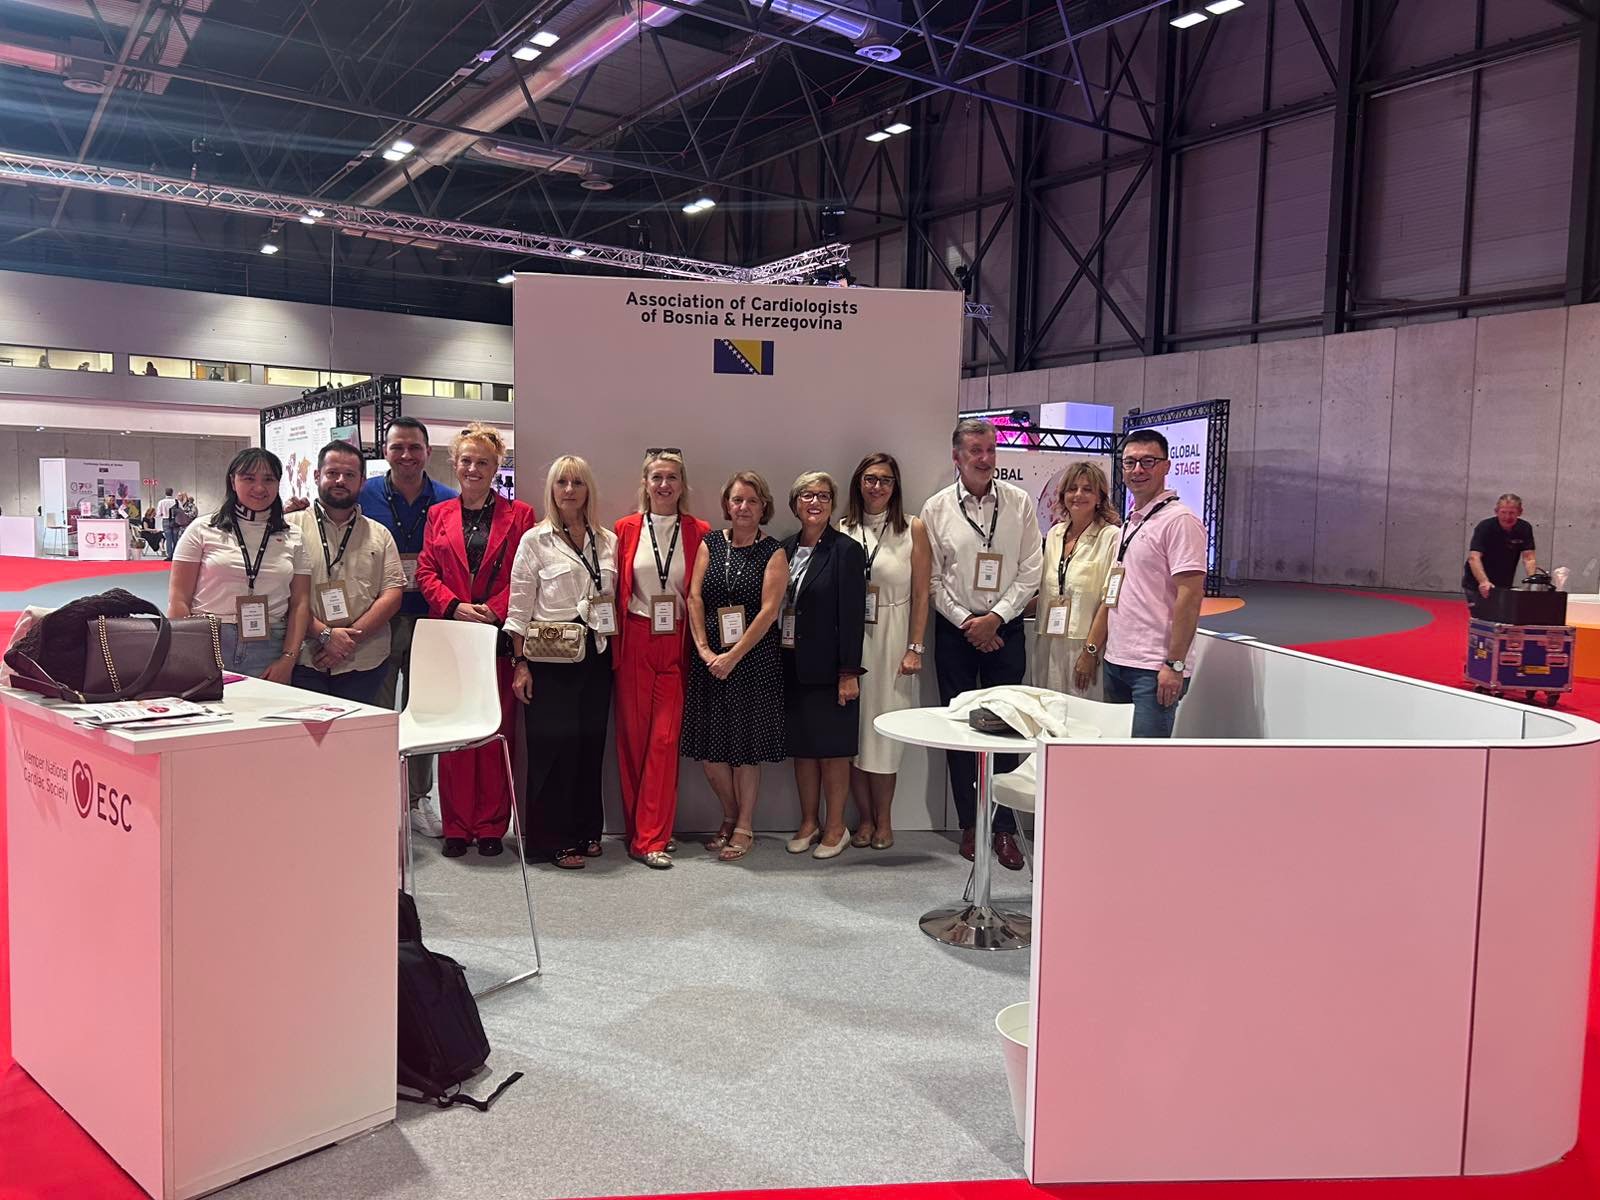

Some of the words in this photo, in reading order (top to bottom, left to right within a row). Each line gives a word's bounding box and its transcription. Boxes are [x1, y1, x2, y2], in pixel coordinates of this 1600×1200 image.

[626, 291, 724, 309] Association
[730, 296, 746, 310] of
[751, 297, 858, 316] Cardiologists
[641, 309, 657, 322] of
[663, 309, 718, 325] Bosnia
[724, 312, 736, 326] &
[742, 313, 842, 331] Herzegovina
[1170, 444, 1200, 459] GLOBAL
[993, 468, 1023, 480] OBAL
[1174, 461, 1200, 476] STAGE
[23, 749, 45, 770] Member
[45, 758, 69, 782] National
[23, 767, 45, 790] Cardiac
[46, 777, 69, 805] Society
[97, 781, 132, 832] ESC
